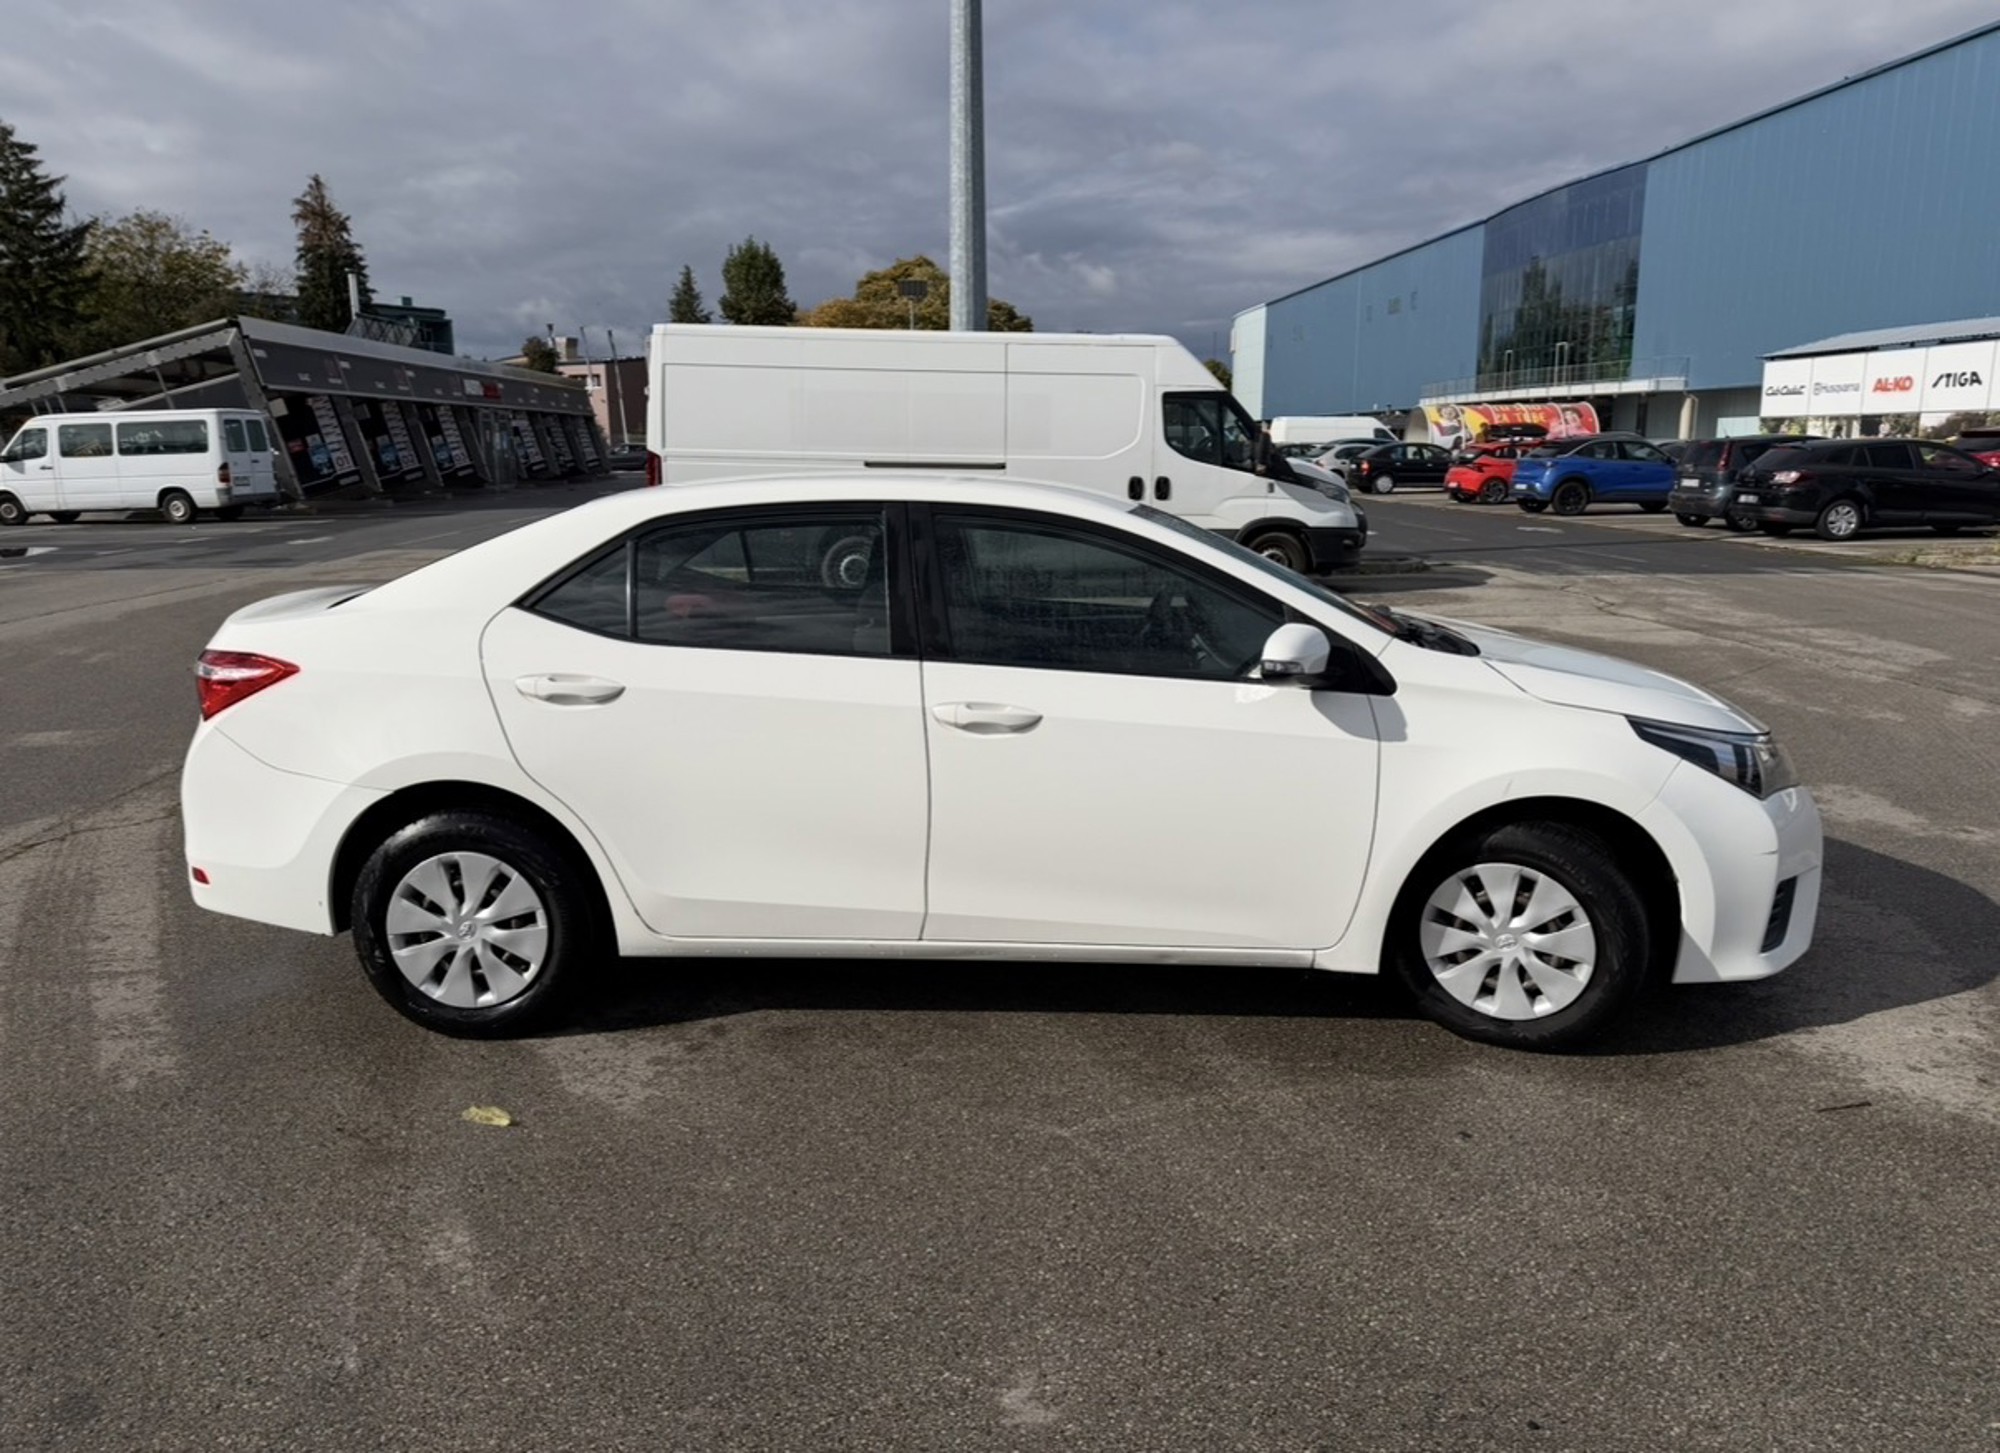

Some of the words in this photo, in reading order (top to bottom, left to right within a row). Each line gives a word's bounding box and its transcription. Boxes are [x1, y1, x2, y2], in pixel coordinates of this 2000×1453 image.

[1872, 376, 1914, 393] AL-KO
[1932, 371, 1983, 389] STIGA
[335, 455, 351, 467] 01
